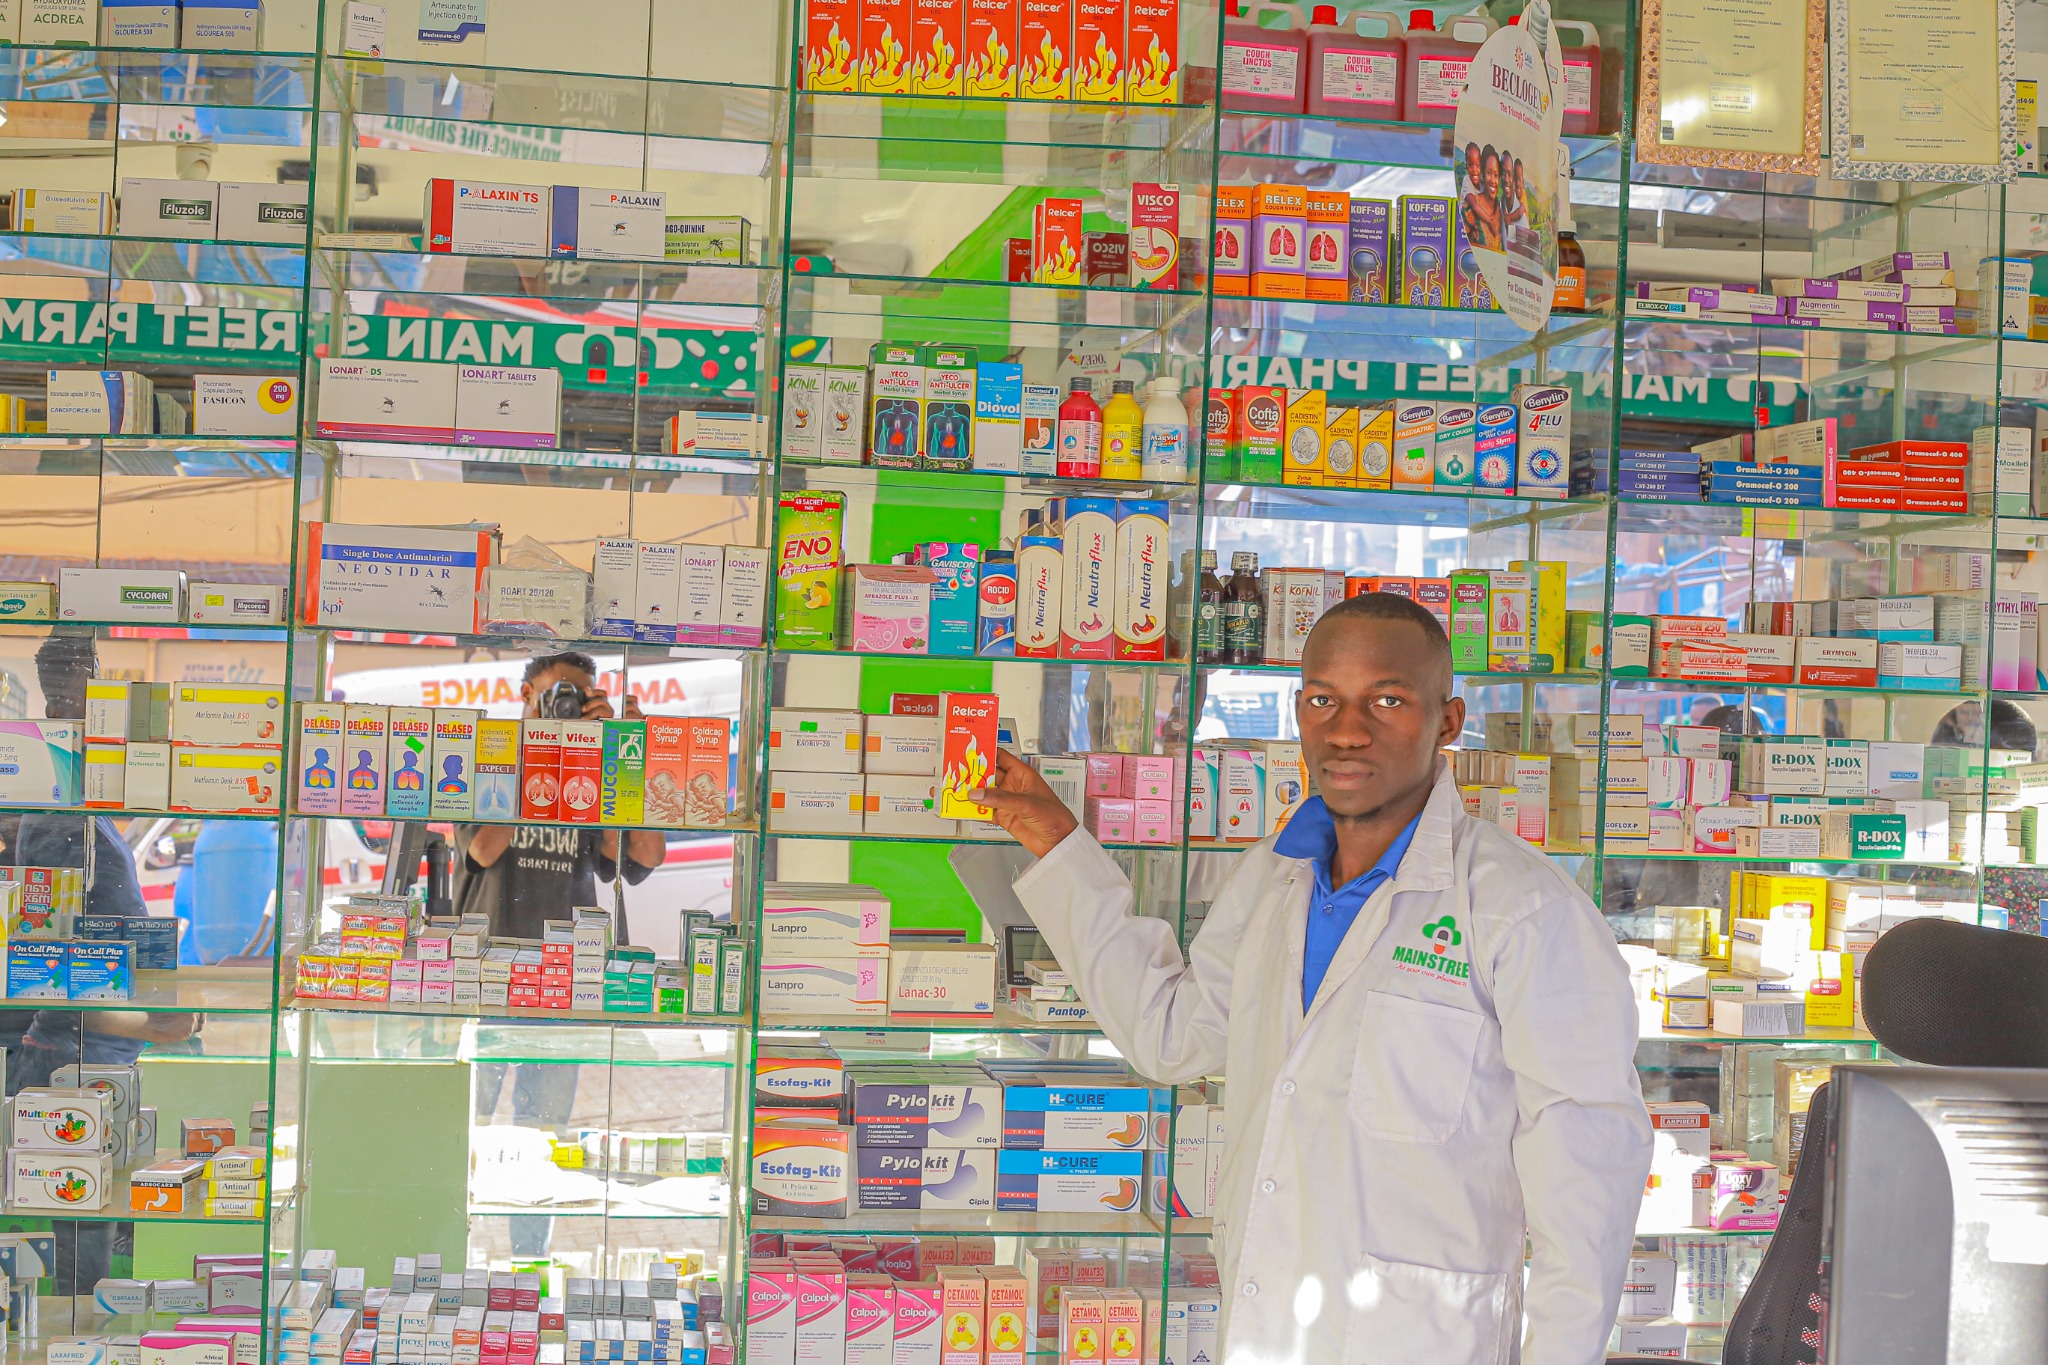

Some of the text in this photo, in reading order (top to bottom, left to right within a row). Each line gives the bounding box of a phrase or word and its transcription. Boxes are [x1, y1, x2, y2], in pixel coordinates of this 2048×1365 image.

[431, 2, 466, 10] Artesunate
[34, 14, 84, 25] ACDREA
[354, 14, 374, 22] Indart
[428, 11, 456, 19] Injection
[1246, 49, 1270, 59] COUGH
[1243, 57, 1272, 67] LINCTUS
[1346, 56, 1371, 65] COUGH
[1344, 64, 1373, 74] LINCTUS
[1492, 64, 1543, 113] BECLOGEN
[610, 195, 660, 206] P-ALAXIN
[1137, 195, 1174, 206] VISCO
[1265, 195, 1301, 205] RELEX
[166, 204, 205, 216] Fluzole
[1351, 205, 1386, 215] KOFF-GO
[1409, 203, 1444, 213] KOFF-GO
[264, 208, 304, 220] Fluzole
[1800, 300, 1840, 312] Augmentin
[462, 370, 537, 381] LONART TABLETS
[890, 370, 909, 379] YECO
[940, 373, 959, 381] YECO
[879, 378, 919, 387] ANTI-ULCER
[929, 381, 970, 390] ANTI-ULCER
[273, 385, 287, 394] 200
[203, 397, 246, 405] FASICON
[978, 401, 1020, 413] Diovol
[1249, 406, 1278, 421] Cofta
[1290, 412, 1318, 420] CADISTIN
[1402, 408, 1432, 420] Benylin
[1443, 411, 1472, 423] Benylin
[1107, 431, 1130, 439] ALCID
[1396, 424, 1435, 438] PAEDIATRIC
[1439, 428, 1473, 440] DRY COUGH
[1906, 450, 1947, 458] Gramocef-O
[1736, 465, 1799, 475] Gramocef-O 200
[1736, 481, 1799, 491] Gramocef-O 200
[1736, 495, 1781, 504] Gramocef-O
[1838, 496, 1880, 504] Gramocef-O
[1906, 499, 1947, 507] Gramocef-O
[599, 541, 634, 549] P-ALAXIN
[641, 546, 676, 554] P-ALAXIN
[783, 537, 832, 560] ENO
[343, 549, 452, 563] Single Dose Antimalarial
[684, 558, 716, 567] LONART
[931, 560, 976, 568] GAVISCON
[1088, 532, 1103, 608] Neutraflux
[126, 591, 168, 599] CYCLOREN
[987, 586, 1009, 594] ROCID
[1290, 584, 1322, 598] KOFNIL
[237, 602, 266, 610] Mycoren
[1880, 602, 1912, 610] THEOFLEX-250
[952, 706, 989, 717] Relcer
[304, 719, 340, 729] DELASED
[348, 720, 384, 731] DELASED
[393, 721, 428, 732] DELASED
[651, 725, 683, 735] Coldcap
[692, 726, 723, 737] Coldcap
[528, 731, 558, 740] Vifex
[566, 733, 597, 743] Vifex
[655, 733, 678, 744] Syrup
[696, 736, 719, 745] Syrup
[796, 739, 830, 747] ESORIV-20
[896, 745, 930, 753] ESORIV-40
[1771, 754, 1815, 765] R-DOX
[480, 765, 510, 773] EXPECT
[602, 728, 620, 817] MUCOLYN
[1780, 814, 1822, 825] R-DOX
[771, 923, 807, 935] Lanpro
[26, 945, 45, 953] Call
[46, 946, 64, 954] Plus
[74, 947, 123, 956] On Call Plus
[558, 945, 569, 953] GEL
[698, 957, 713, 965] AXE
[1392, 946, 1469, 979] MAINSTREE
[545, 967, 556, 975] GO!
[768, 980, 804, 991] Lanpro
[898, 986, 947, 1000] Lanac-30
[767, 1078, 832, 1088] Esofag-Kit
[886, 1094, 956, 1107] Pylo kit
[1049, 1093, 1105, 1106] H-CURE
[18, 1109, 61, 1118] Multiren
[976, 1136, 997, 1144] Cipla
[218, 1162, 246, 1170] Antinal
[880, 1156, 948, 1171] Pylo kit
[18, 1168, 61, 1177] Multiren
[760, 1162, 842, 1178] Esofag-Kit
[1721, 1171, 1753, 1186] Kloxy
[222, 1183, 250, 1191] Antinal
[219, 1202, 247, 1210] Antinal
[752, 1292, 781, 1302] Calpol
[801, 1293, 829, 1303] Calpol
[947, 1289, 979, 1300] CETAMOL
[991, 1289, 1022, 1301] CETAMOL
[851, 1308, 879, 1318] Calpol
